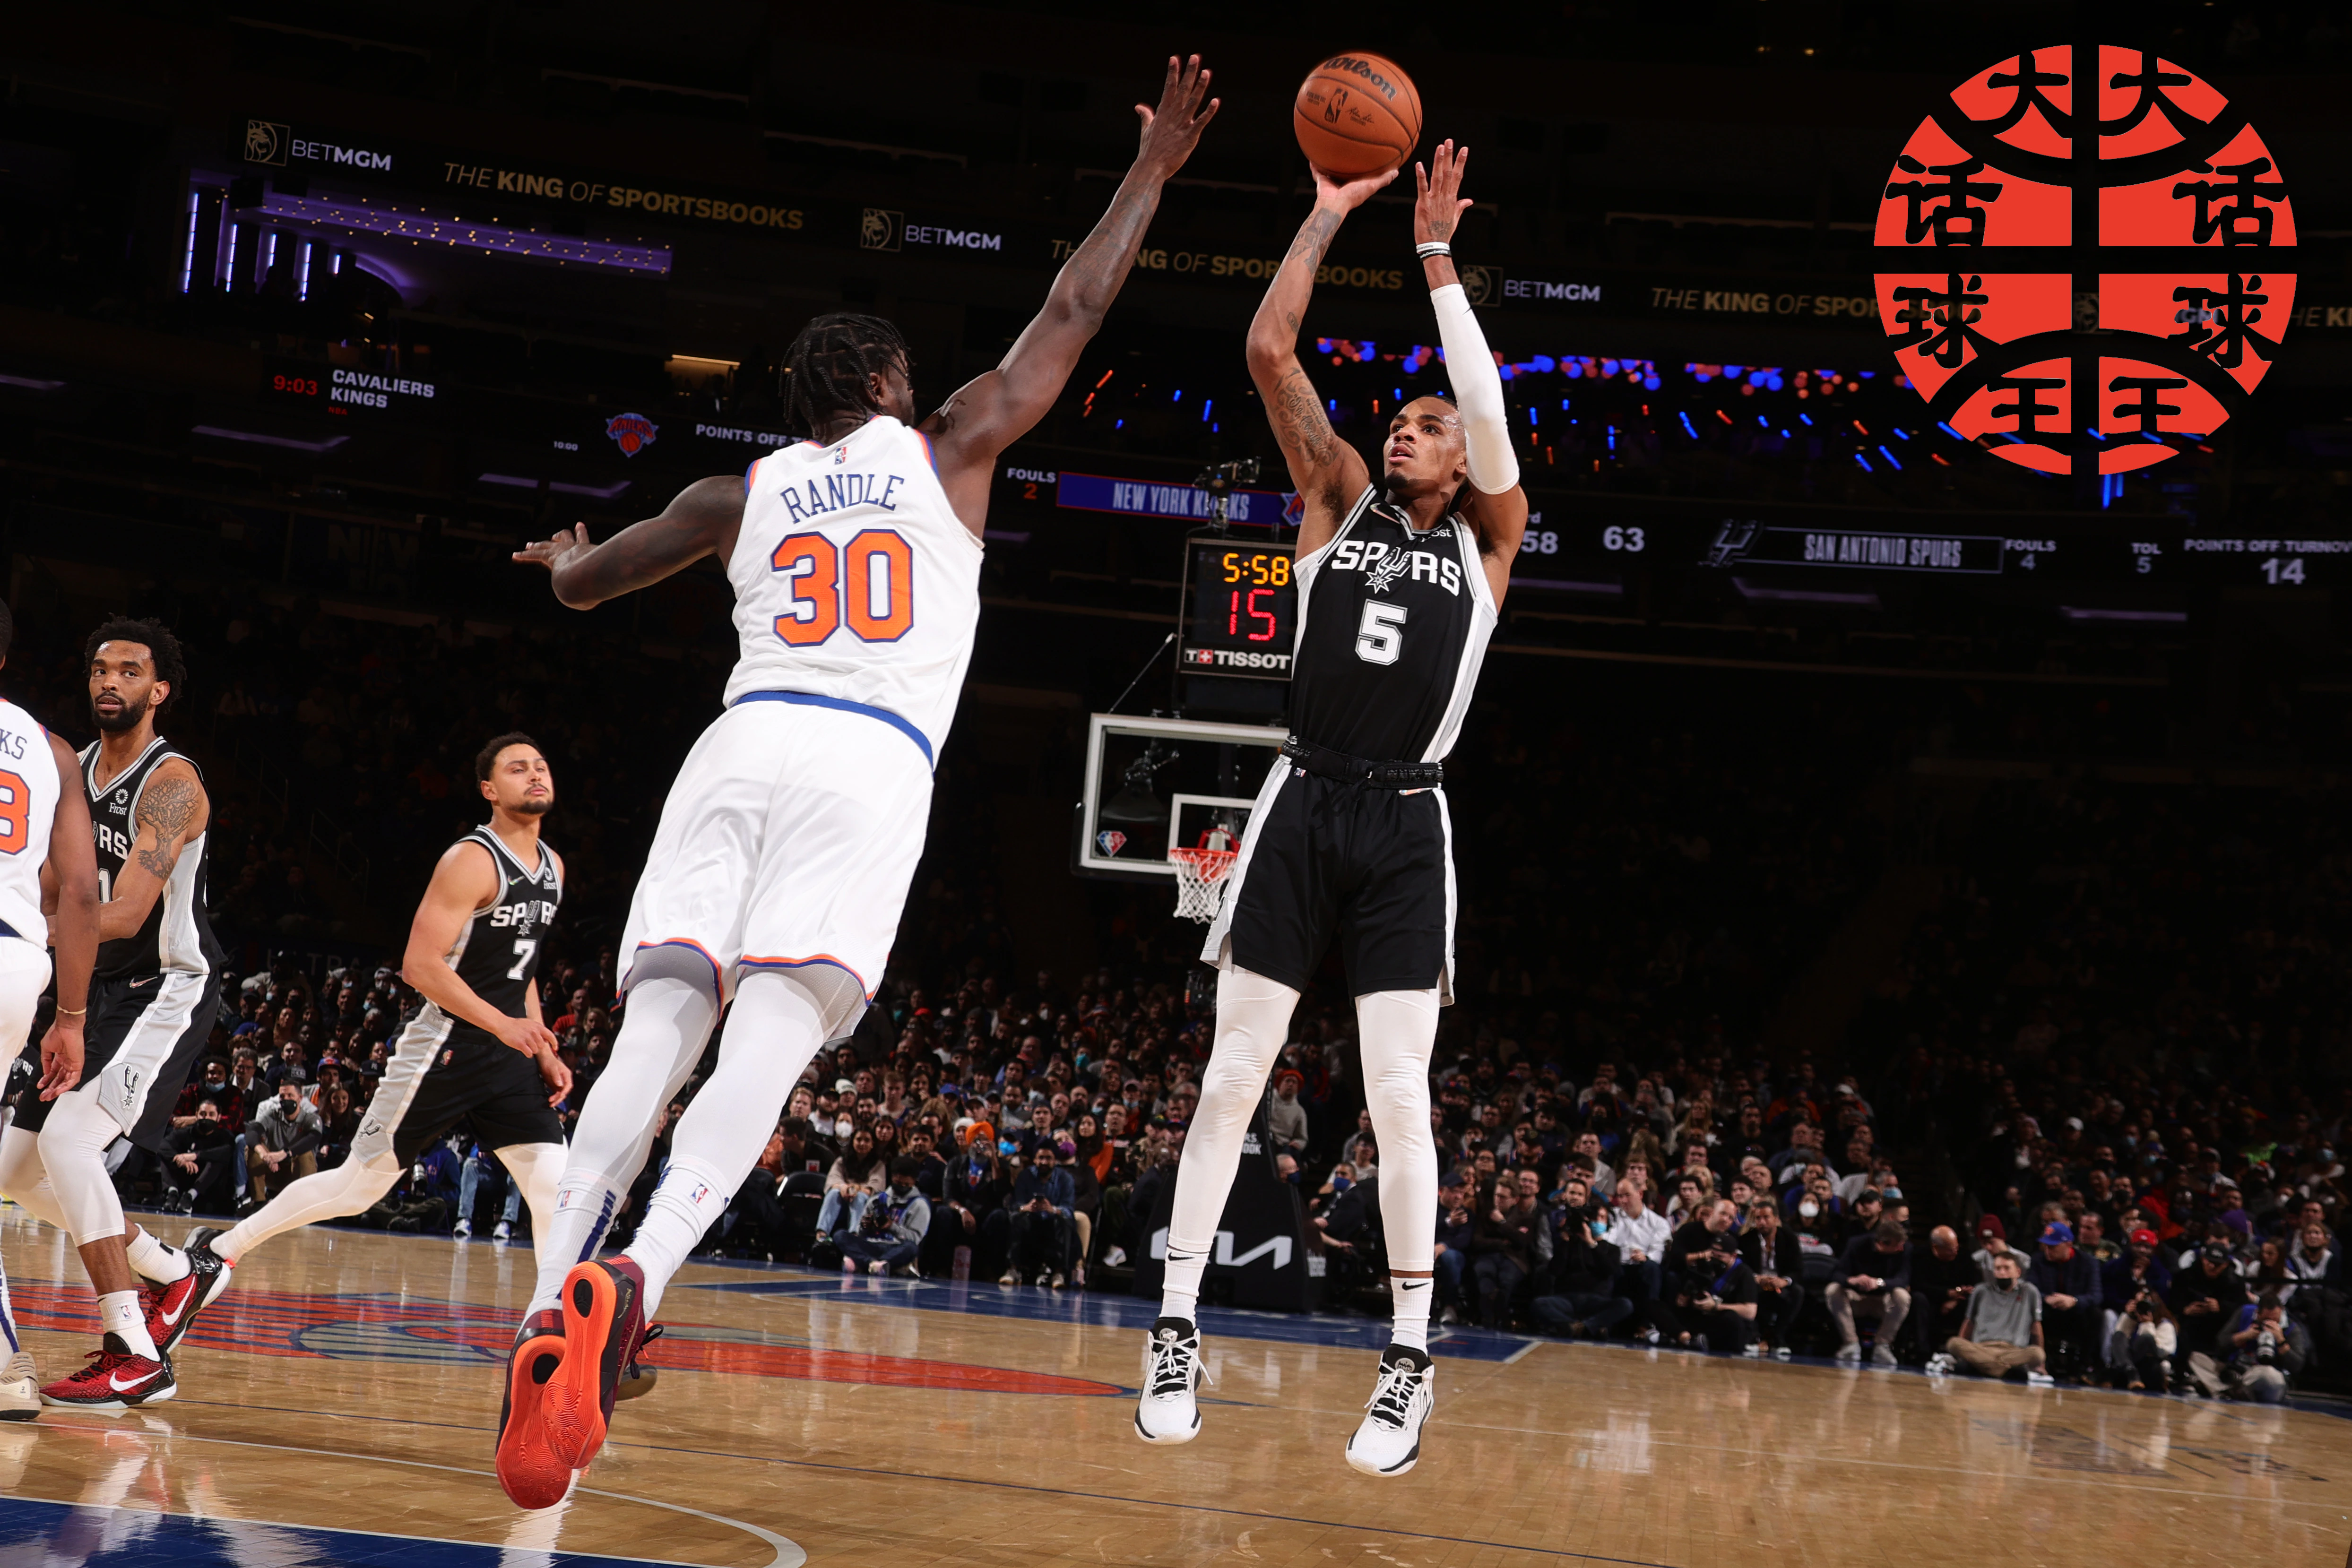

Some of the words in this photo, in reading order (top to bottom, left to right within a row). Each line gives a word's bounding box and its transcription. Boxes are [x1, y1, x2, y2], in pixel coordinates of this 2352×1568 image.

[1323, 57, 1397, 102] Wilson
[291, 138, 392, 171] BETMGM
[443, 162, 494, 188] THE
[497, 170, 563, 198] KING
[569, 181, 606, 204] OF
[606, 186, 804, 230] SPORTSBOOKS
[905, 224, 1002, 251] BETMGM
[1050, 239, 1082, 261] TH
[1172, 252, 1209, 273] OF
[1210, 254, 1404, 291] SPORBOOKS
[1503, 279, 1601, 302] BETMGM
[1651, 287, 1698, 310] THE
[1703, 291, 1770, 314] KING
[1774, 294, 1812, 315] OF
[273, 374, 319, 396] 9:03
[332, 369, 435, 399] CAVALIERS
[330, 387, 389, 409] KINGS
[553, 440, 579, 452] 10:00
[695, 423, 753, 443] POINTS
[757, 432, 788, 447] OFF
[1006, 466, 1057, 483] FOULS
[780, 474, 905, 524] RANDLE
[1023, 482, 1038, 500] 2
[1112, 482, 1147, 511] NEW
[1150, 483, 1189, 516] YORK
[1520, 529, 1559, 555] 58
[1602, 525, 1646, 552] 63
[1804, 533, 1836, 562] SAN
[1839, 535, 1906, 566] ANTONIO
[1909, 539, 1963, 569] SPURS
[2004, 538, 2057, 553] FOULS
[2130, 542, 2162, 557] TOL
[2183, 538, 2245, 552] POINTS
[2248, 538, 2281, 553] OFF
[1222, 552, 1290, 587] 5:58
[2020, 553, 2037, 571] 4
[2136, 556, 2152, 574] 5
[2259, 557, 2307, 586] 14
[770, 528, 914, 648] 30
[1228, 587, 1277, 642] 15
[1355, 598, 1408, 666] 5
[1214, 650, 1291, 670] TISSOT
[109, 802, 128, 816] Frost
[507, 938, 538, 981] 7
